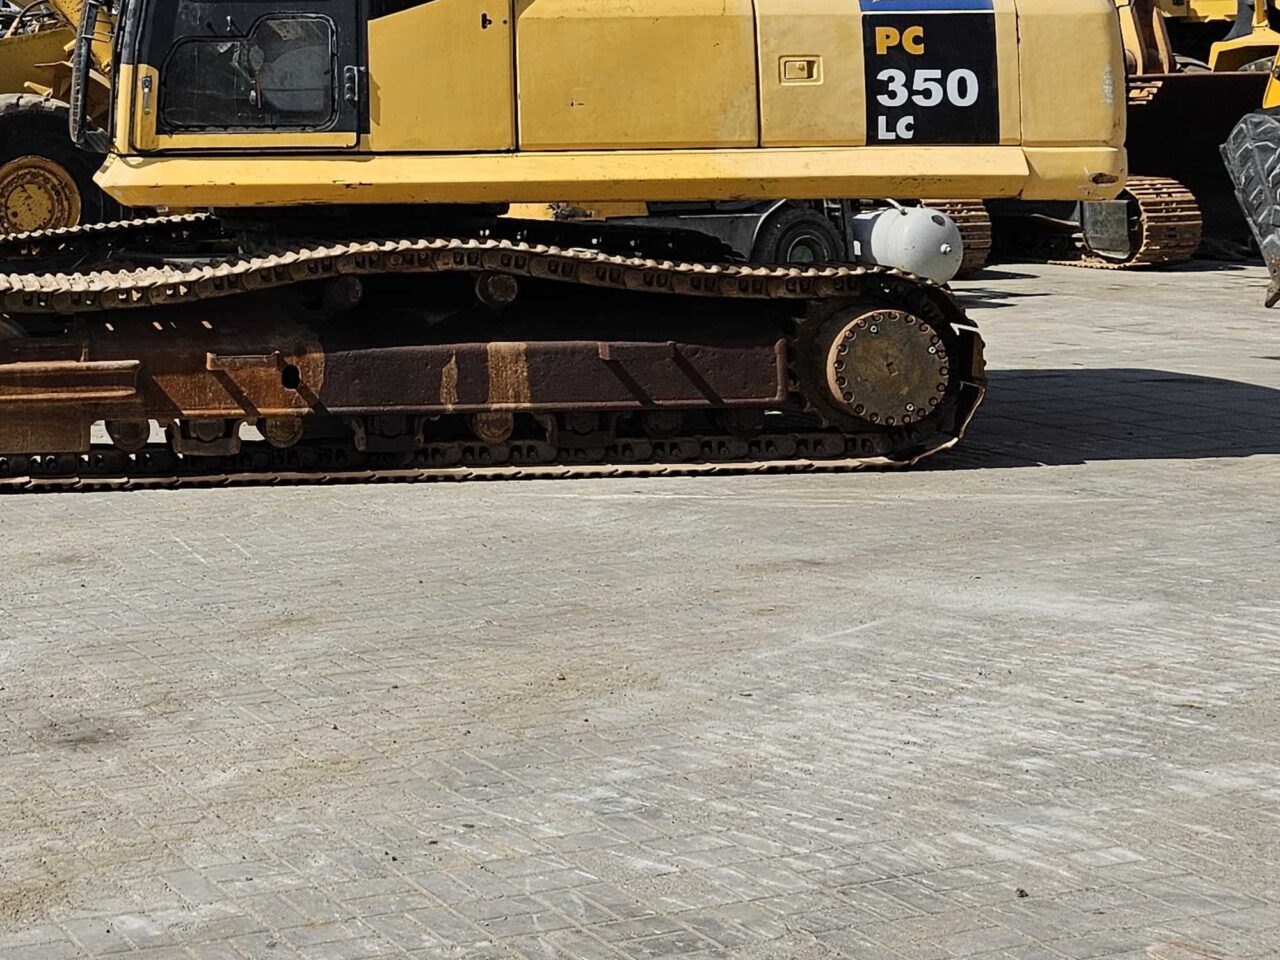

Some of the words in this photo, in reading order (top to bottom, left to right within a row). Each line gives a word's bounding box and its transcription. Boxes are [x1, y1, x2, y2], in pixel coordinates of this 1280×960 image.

[875, 25, 925, 55] PC
[876, 68, 979, 107] 350
[878, 115, 915, 140] LC
